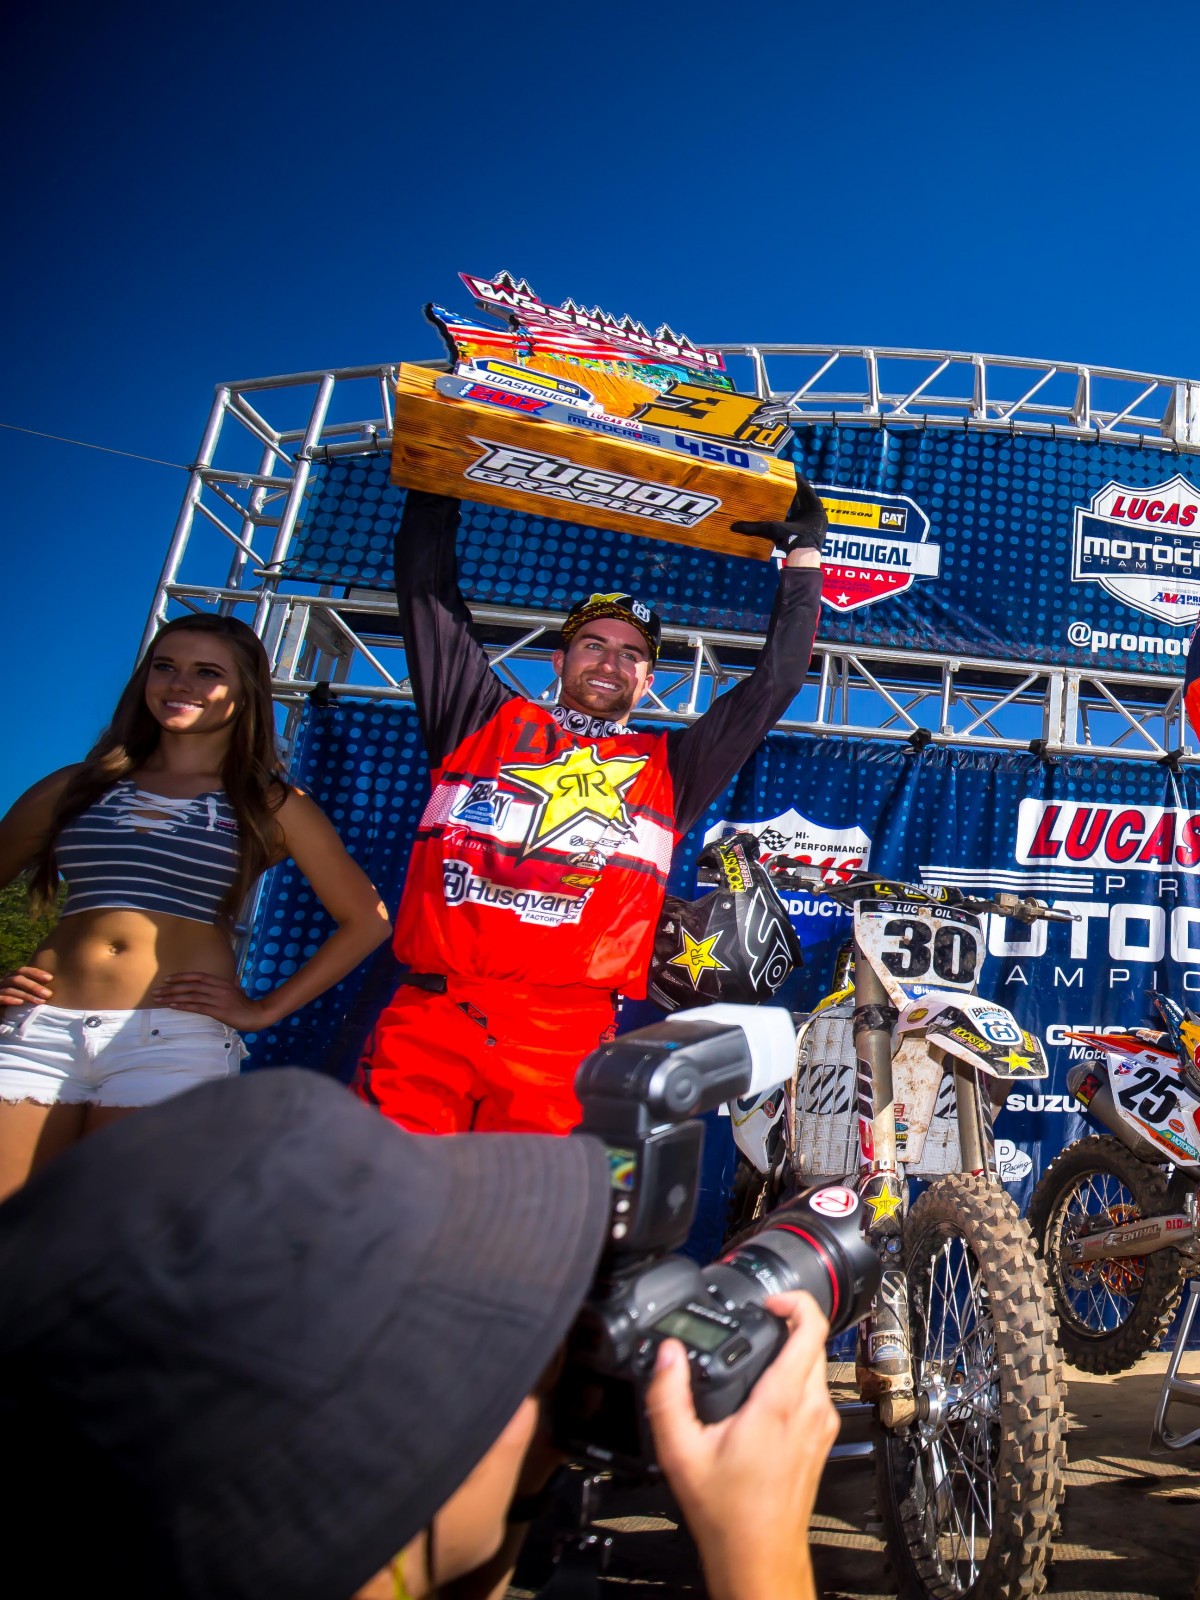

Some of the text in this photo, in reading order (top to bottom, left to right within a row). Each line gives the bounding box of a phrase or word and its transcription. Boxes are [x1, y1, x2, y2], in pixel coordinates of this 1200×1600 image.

[471, 278, 719, 368] Washougal
[467, 385, 548, 413] 2017
[485, 374, 579, 407] WASHOUGAL
[590, 413, 640, 430] LUCAS OIL
[637, 382, 787, 446] 3rd
[568, 415, 661, 445] MOTOCROSS
[674, 434, 750, 469] 450
[881, 512, 906, 526] CAT
[1110, 496, 1198, 527] LUCAS
[822, 539, 912, 567] SHOUGAL
[824, 567, 897, 583] TIONAL
[1151, 592, 1186, 605] AMA
[794, 842, 868, 854] PERFORMANCE
[795, 831, 810, 840] HI-
[934, 909, 953, 918] OIL
[881, 918, 977, 984] 30
[1118, 1067, 1185, 1124] 25
[1171, 1135, 1198, 1158] MOTOREX
[1002, 1161, 1033, 1177] Racing
